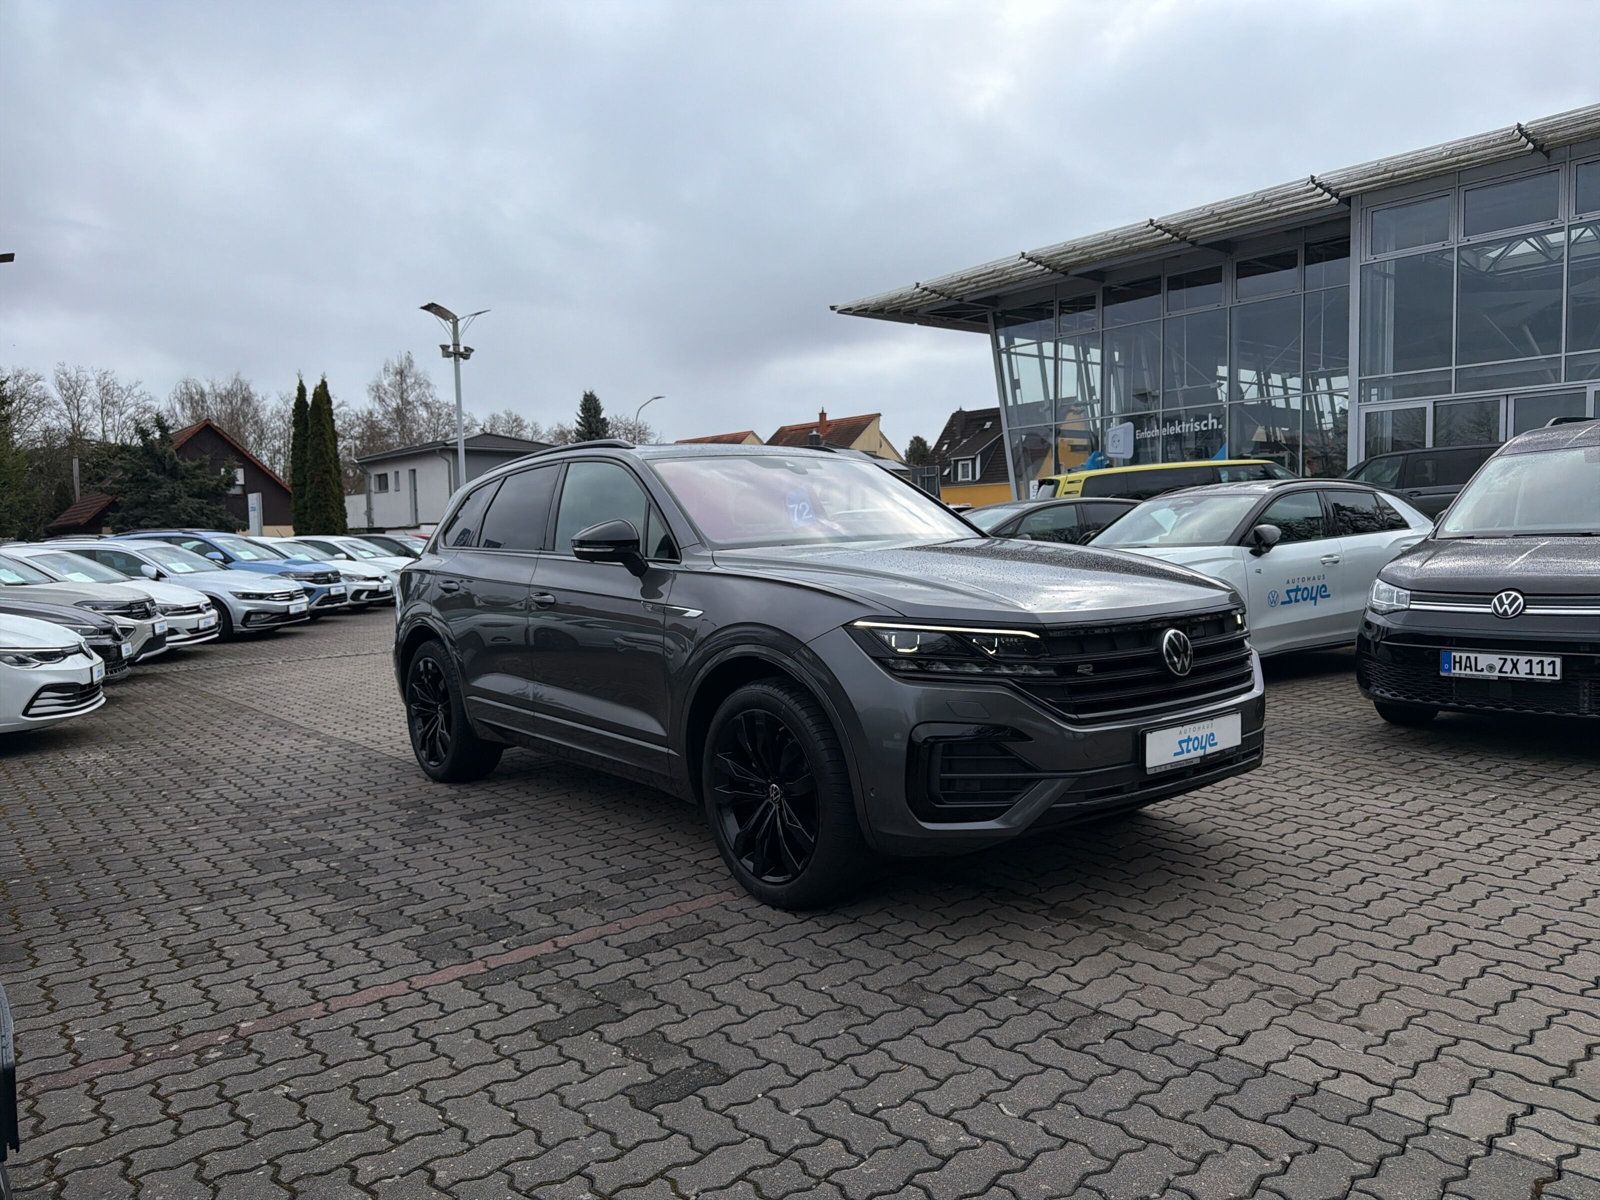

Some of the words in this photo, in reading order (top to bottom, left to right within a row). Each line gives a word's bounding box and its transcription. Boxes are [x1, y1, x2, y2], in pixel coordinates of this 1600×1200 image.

[1135, 424, 1160, 440] Einfach
[1161, 412, 1223, 436] elektrisch.
[1286, 574, 1326, 585] AUTOHAUS
[1491, 591, 1523, 618] VW
[1163, 629, 1191, 675] VW
[1453, 655, 1484, 672] HAL
[1498, 657, 1520, 675] ZX
[1524, 659, 1558, 677] 111
[1179, 723, 1213, 735] AUTOHAUS
